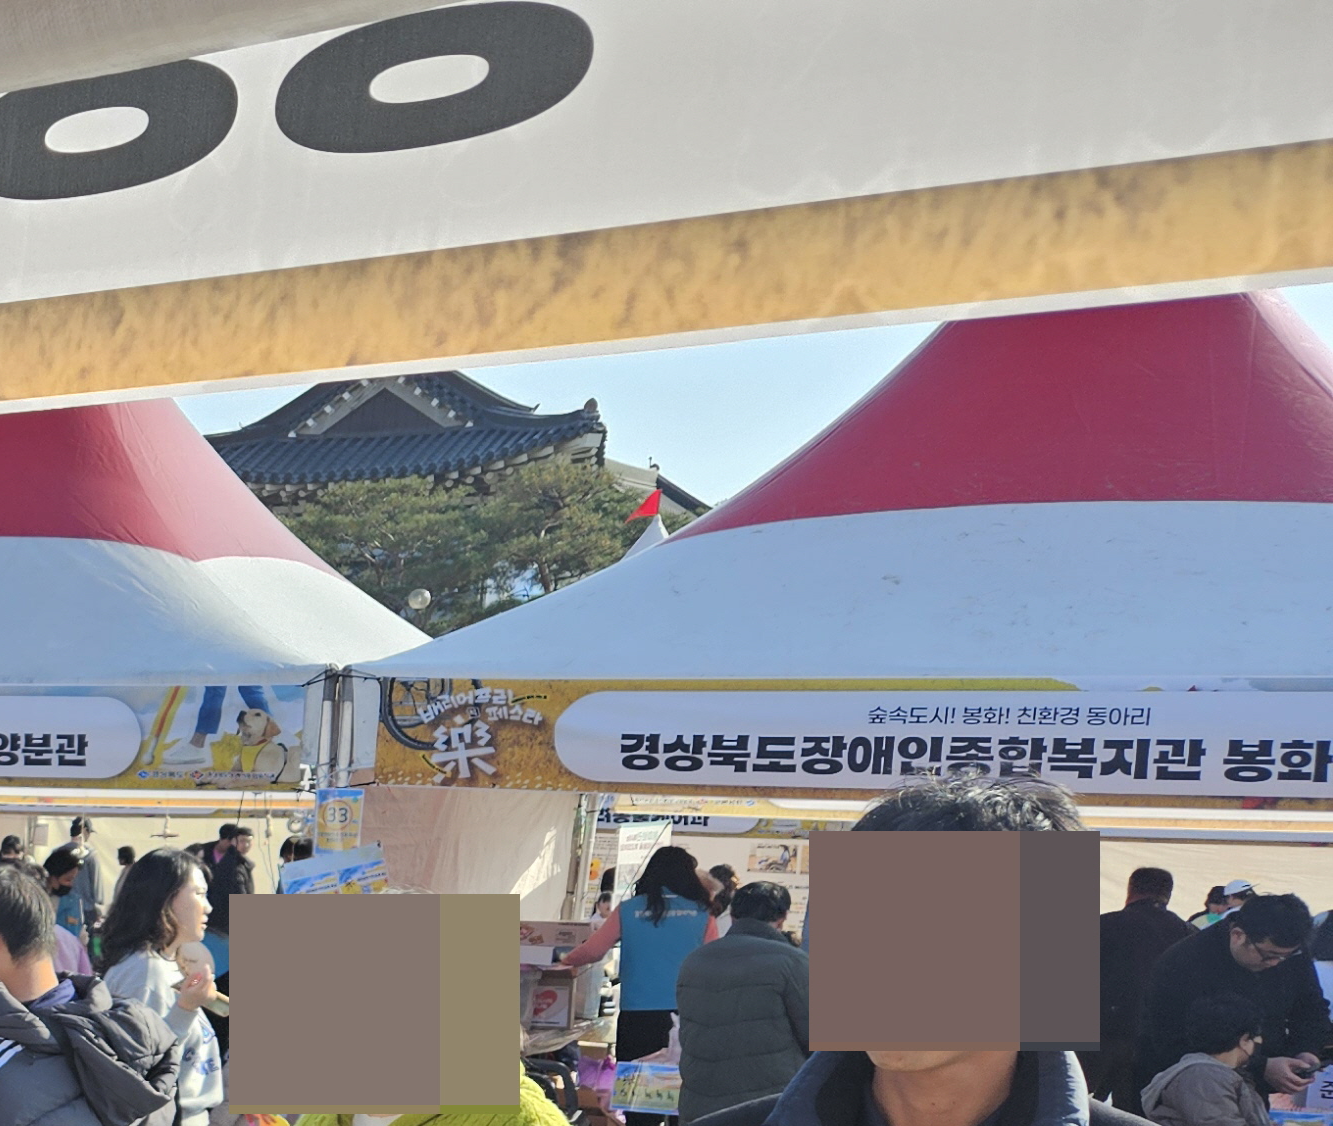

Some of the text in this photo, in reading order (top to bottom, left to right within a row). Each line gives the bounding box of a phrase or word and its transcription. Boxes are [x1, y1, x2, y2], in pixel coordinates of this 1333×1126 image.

[868, 706, 1151, 727] 숲속도시! 봉화! 친환경 동아리
[620, 734, 1206, 780] 경상북도장애인종합복지관
[328, 806, 348, 823] 33
